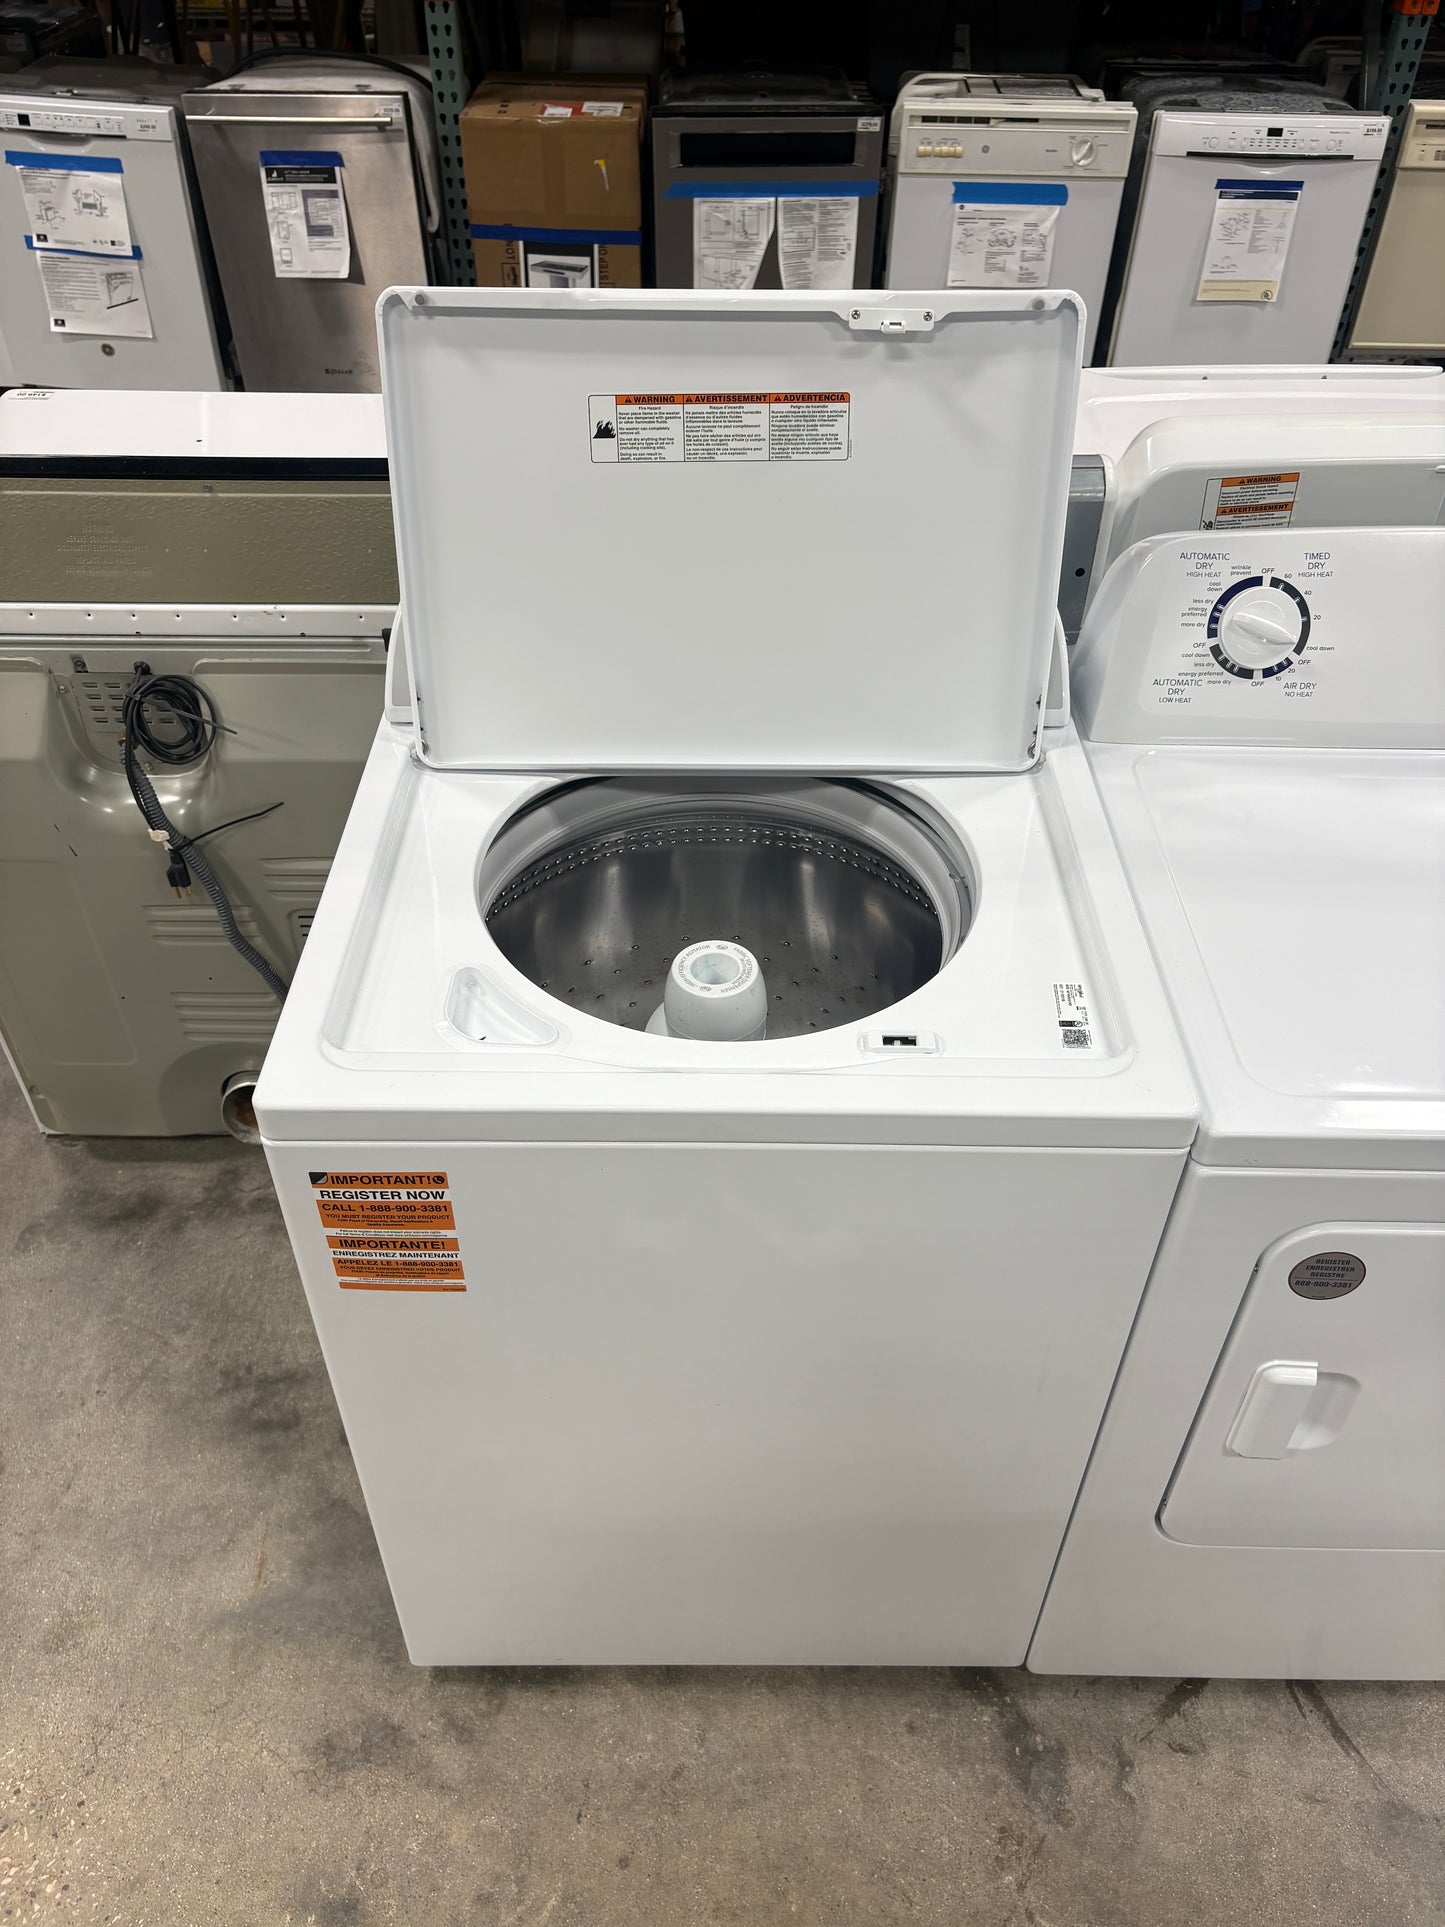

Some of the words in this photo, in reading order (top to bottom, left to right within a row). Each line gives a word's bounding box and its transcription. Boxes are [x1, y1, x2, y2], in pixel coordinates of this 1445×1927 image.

[600, 257, 609, 281] STEP
[633, 395, 675, 403] WARNING
[694, 395, 767, 403] AVERTISSEMENT
[783, 394, 845, 402] ADVERTENCIA
[1246, 476, 1281, 484] WARNING
[1228, 503, 1289, 513] AVERTISSEMENT
[1179, 552, 1231, 561] AUTOMATIC
[1304, 552, 1331, 560] TIMED
[1195, 562, 1214, 570] DRY
[1307, 562, 1326, 570] DRY
[1152, 679, 1203, 687] AUTOMATIC
[1283, 682, 1298, 690] AIR
[1299, 682, 1317, 690] DRY
[1167, 688, 1186, 696] DRY
[330, 1175, 431, 1185] IMPORTANT!
[319, 1189, 401, 1200] REGISTER
[406, 1190, 445, 1200] NOW
[321, 1203, 356, 1212] CALL
[359, 1204, 448, 1212] 1-888-900-3381
[338, 1239, 445, 1250] IMPORTANTE!
[332, 1250, 398, 1258] ENREGISTREZ
[380, 1259, 393, 1267] LE
[1310, 1271, 1346, 1279] REGISTRE
[1294, 1280, 1352, 1288] 888-900-3381
